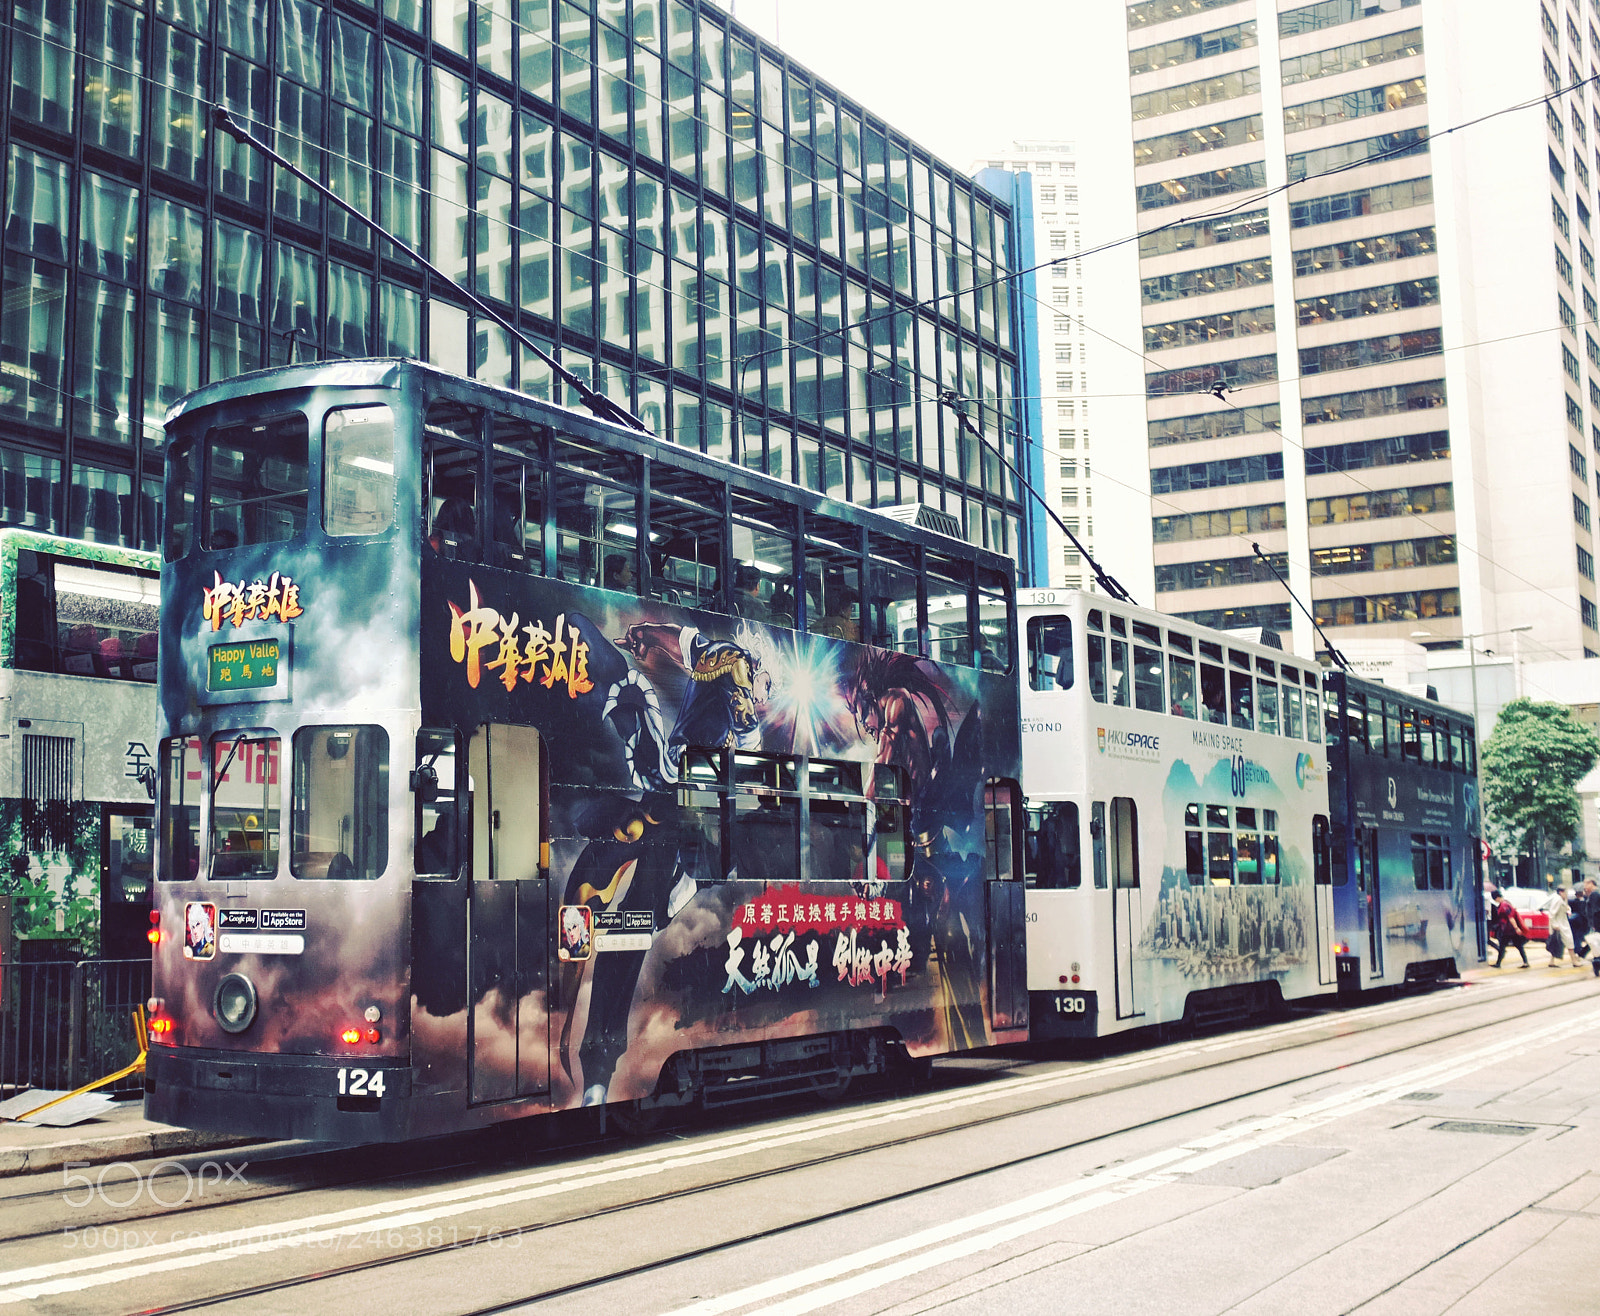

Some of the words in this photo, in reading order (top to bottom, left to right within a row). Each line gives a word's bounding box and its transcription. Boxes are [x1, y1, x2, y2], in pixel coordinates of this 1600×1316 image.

[203, 569, 304, 632] 中華英雄
[1030, 592, 1056, 604] 130
[447, 578, 595, 699] 中華英雄
[213, 648, 246, 664] Happy
[249, 643, 279, 660] Valley
[220, 663, 275, 682] 跑馬地
[1192, 730, 1220, 748] MAKING
[1222, 735, 1243, 753] SPACE
[1231, 754, 1246, 798] 60
[1245, 767, 1270, 783] BEYOND
[228, 915, 245, 924] Google
[245, 915, 256, 924] play
[270, 918, 284, 927] App
[284, 917, 303, 926] Store
[632, 918, 640, 927] App
[742, 902, 895, 925] 原著正版授權手機遊戲
[1055, 997, 1086, 1013] 130
[337, 1069, 386, 1098] 124
